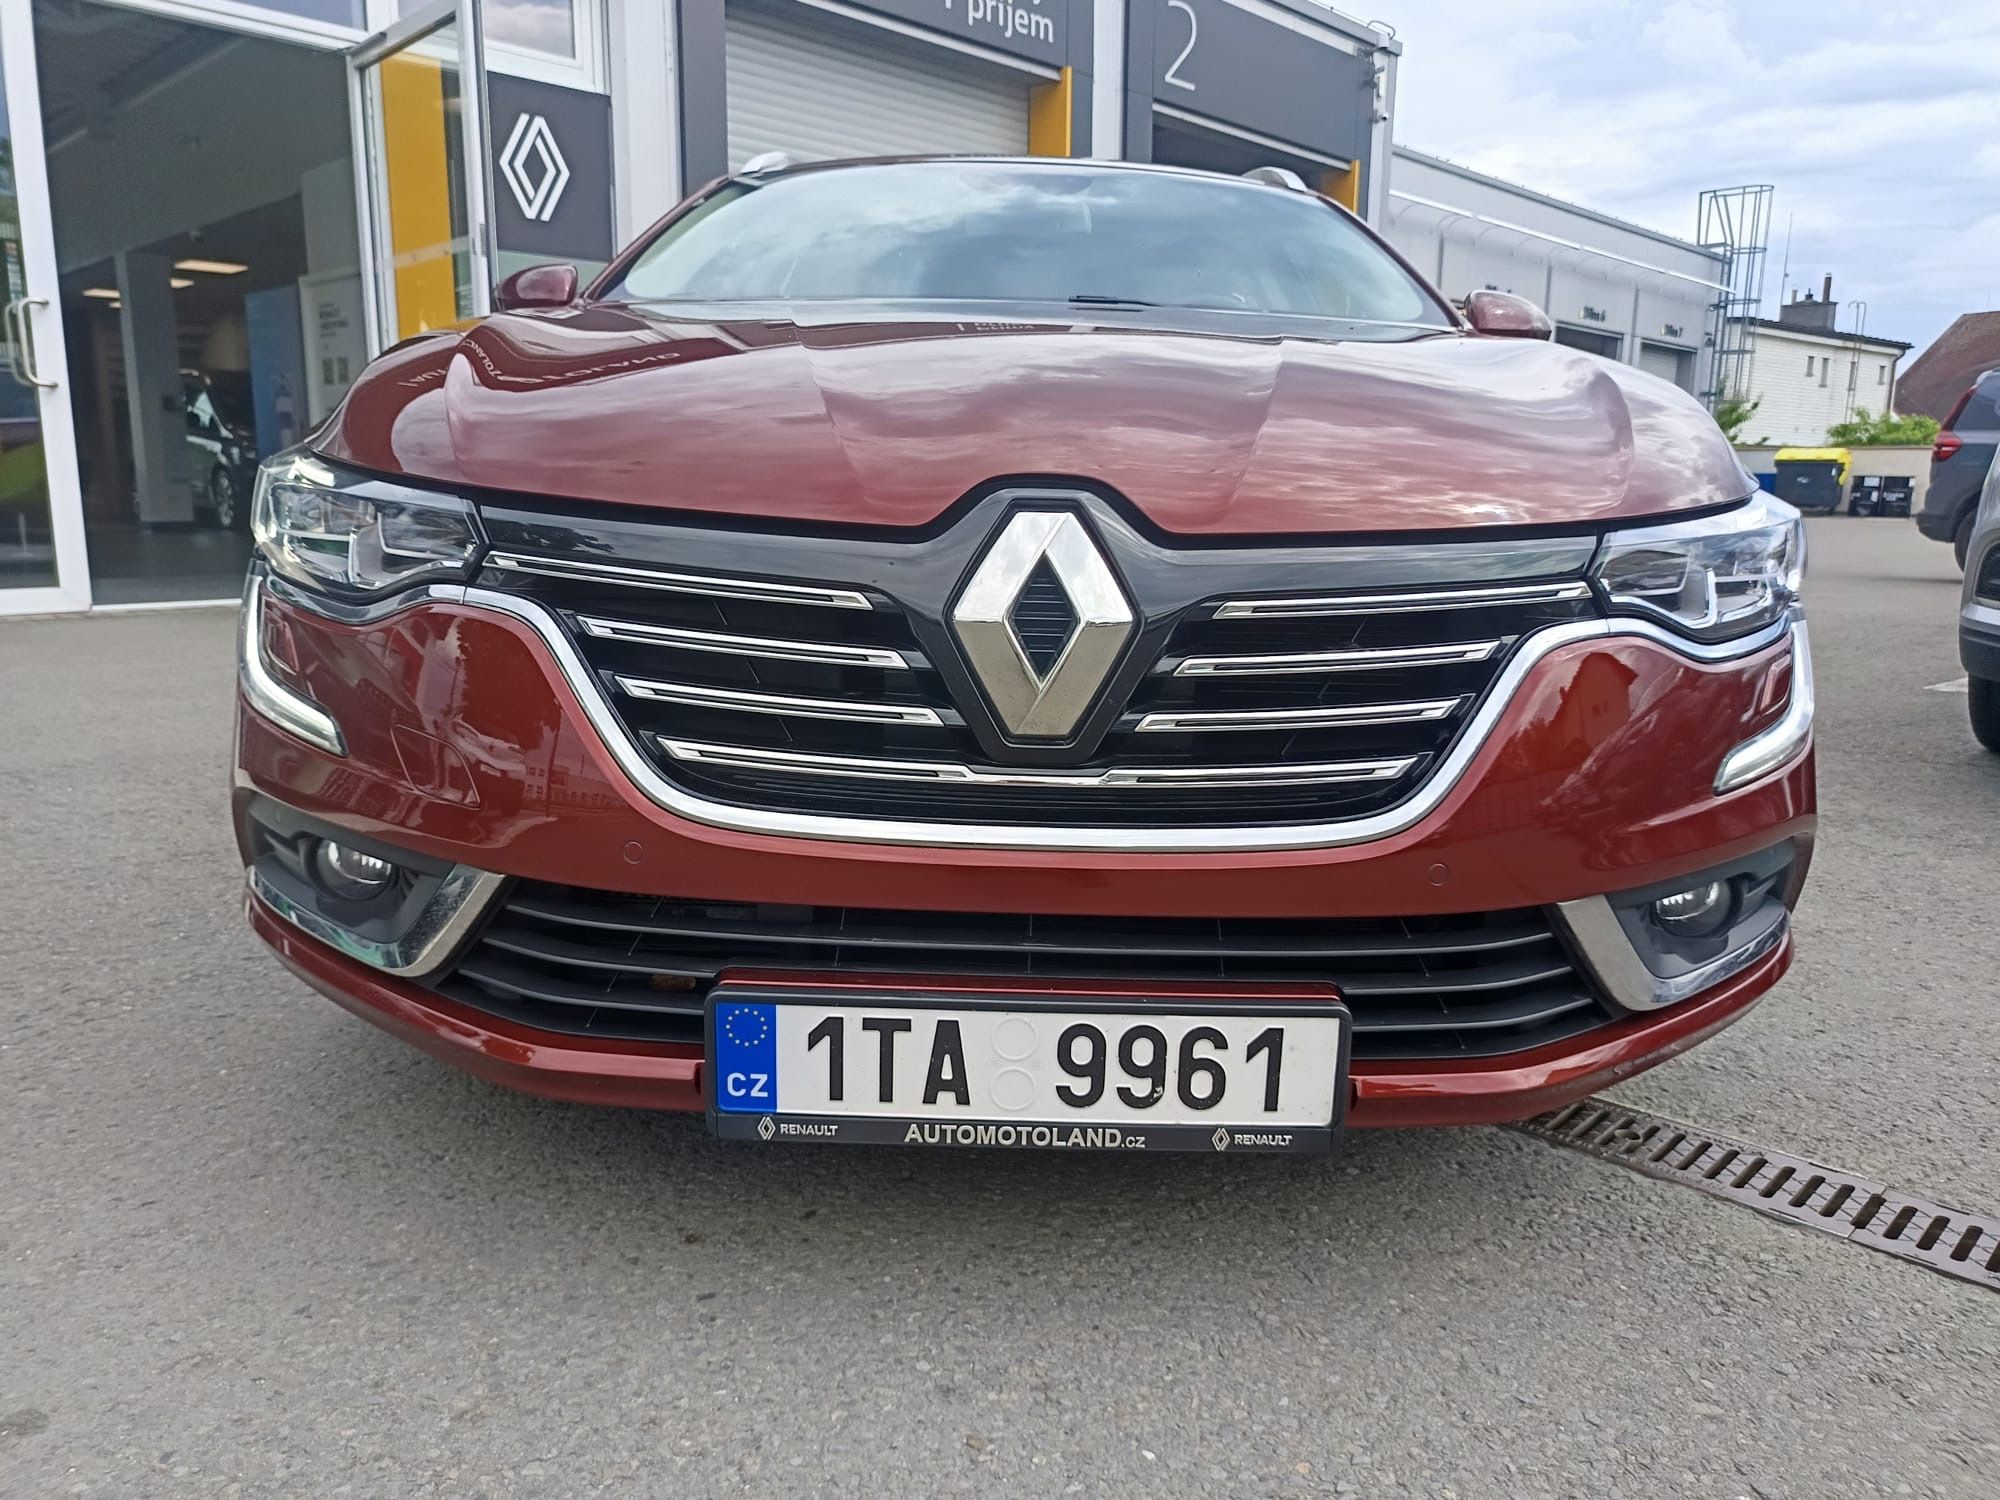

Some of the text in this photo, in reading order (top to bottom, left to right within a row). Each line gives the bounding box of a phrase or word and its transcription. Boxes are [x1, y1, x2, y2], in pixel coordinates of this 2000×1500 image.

[1164, 0, 1197, 91] 2
[808, 1016, 1284, 1112] 1TA 9961
[727, 1072, 768, 1097] CZ
[780, 1123, 838, 1136] RENAULT
[1234, 1134, 1293, 1146] RENAULT
